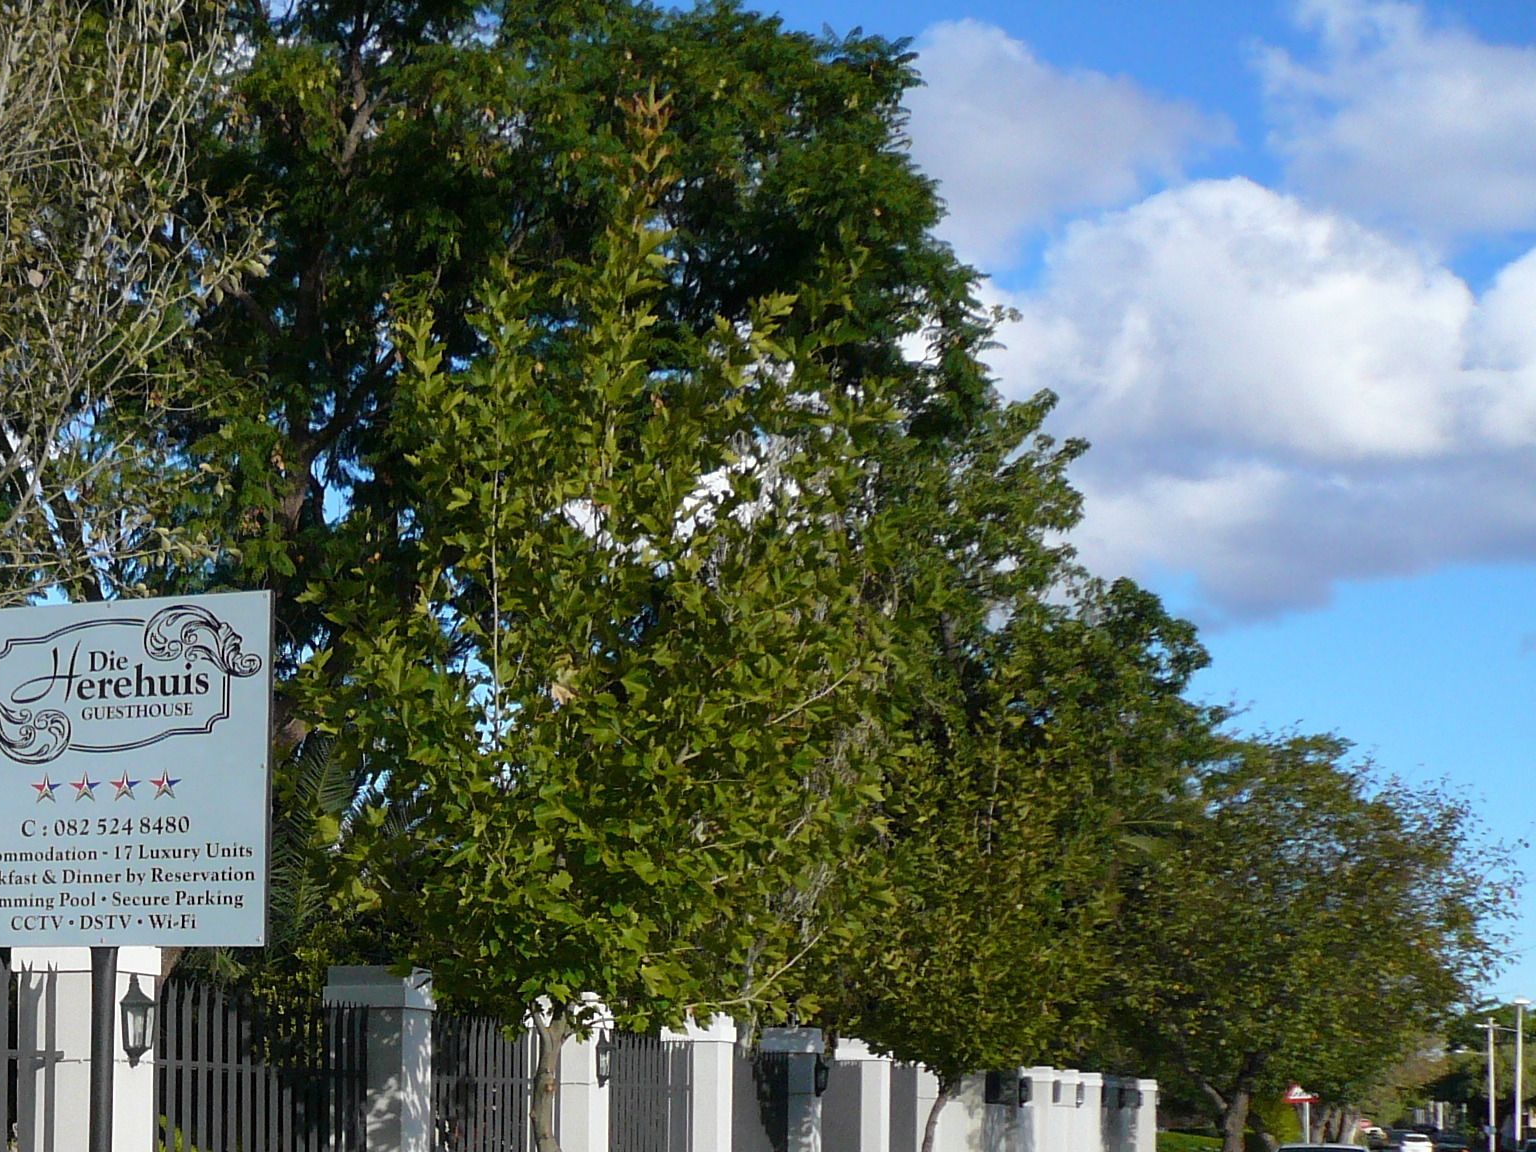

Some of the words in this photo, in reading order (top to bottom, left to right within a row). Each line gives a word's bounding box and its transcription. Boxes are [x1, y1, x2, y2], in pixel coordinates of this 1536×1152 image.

[11, 639, 210, 703] Herehuis
[88, 649, 128, 673] Die
[81, 702, 194, 720] GUESTHOUSE
[20, 819, 36, 837] C
[54, 818, 90, 836] 082
[97, 817, 133, 836] 524
[139, 816, 191, 834] 8480
[114, 845, 132, 860] 17
[139, 844, 201, 862] Luxury
[205, 842, 254, 859] Units
[42, 870, 57, 884] &
[62, 869, 122, 884] Dinner
[126, 868, 146, 886] by
[151, 866, 256, 883] Reservation
[59, 891, 96, 907] Pool
[112, 891, 170, 906] Secure
[175, 890, 244, 908] Parking
[11, 915, 64, 931] CCTV
[80, 914, 132, 930] DSTV
[149, 913, 198, 929] Wi-Fi
